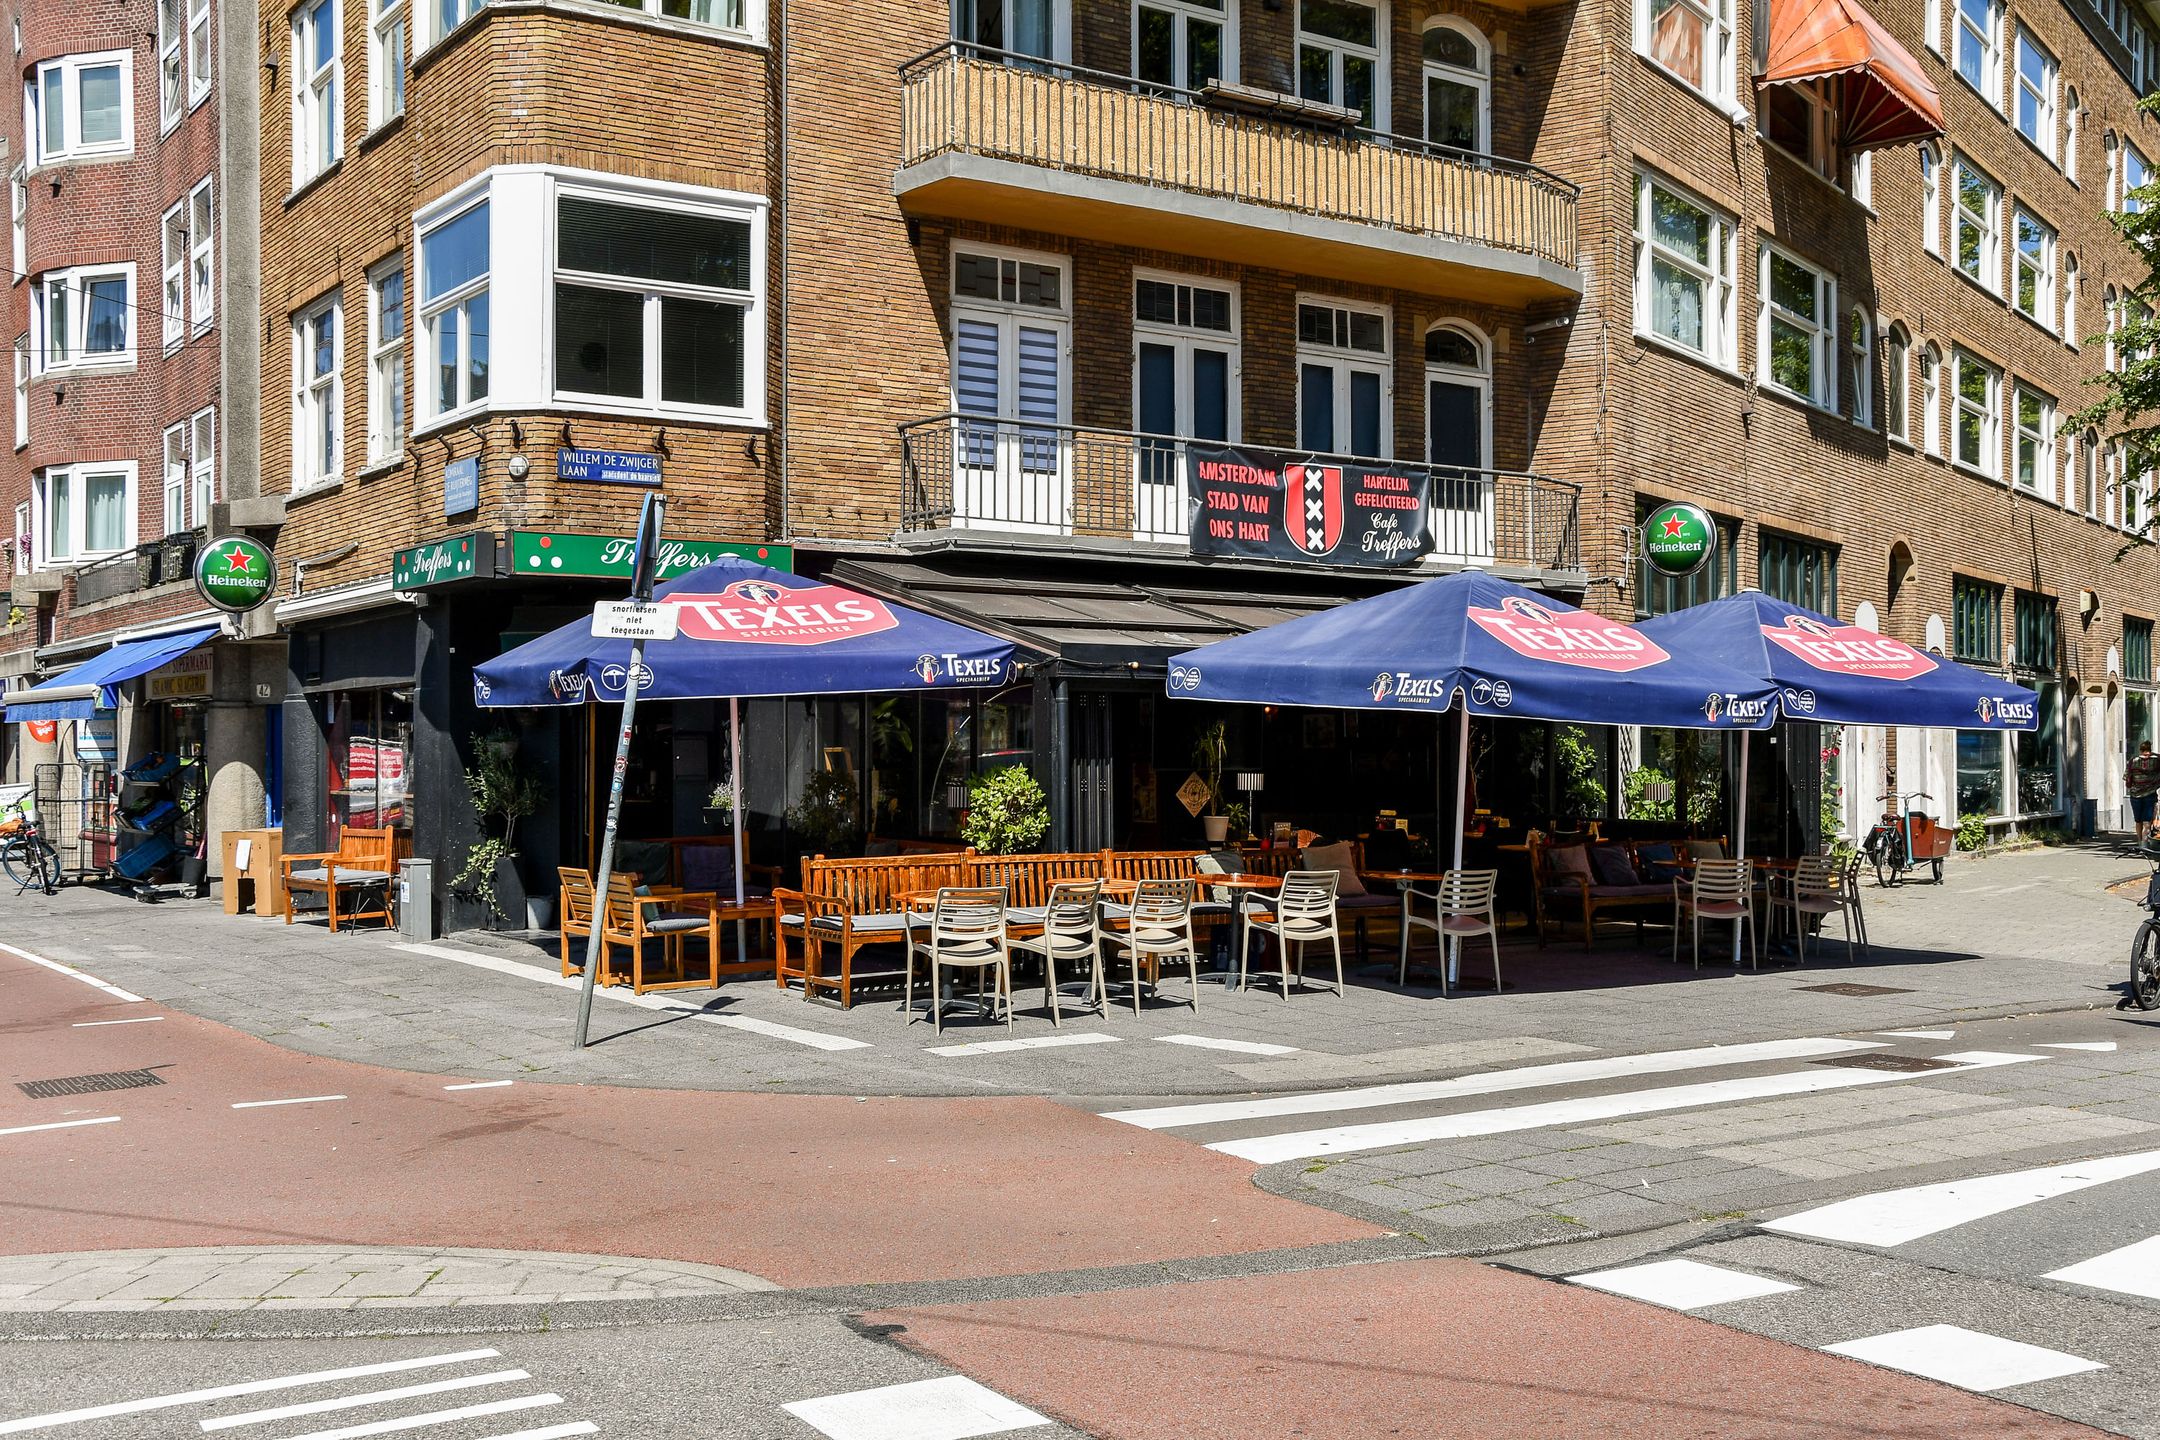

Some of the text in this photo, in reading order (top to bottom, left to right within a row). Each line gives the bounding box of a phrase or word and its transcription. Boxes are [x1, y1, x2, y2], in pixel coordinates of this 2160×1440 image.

[562, 465, 588, 477] LAAN
[563, 451, 659, 471] WILLEM DE ZWIJGER
[1199, 461, 1278, 487] AMSTERDAM
[1363, 475, 1410, 491] HARTELIJK
[1207, 490, 1270, 514] STAD VAN
[1355, 492, 1420, 510] GEFELICITEERD
[1209, 518, 1270, 542] ONS HART
[1371, 512, 1398, 535] Cafe
[1361, 531, 1421, 560] Treffers
[1649, 541, 1702, 553] Heineken
[413, 545, 452, 582] Treffers
[600, 539, 711, 577] Trffers
[207, 574, 267, 588] Heineken
[612, 605, 657, 614] snorfietsen
[626, 616, 642, 624] niet
[672, 599, 878, 631] TEXELS
[611, 626, 655, 636] toegestaan
[740, 625, 853, 638] SPECIAALBIER
[1479, 615, 1645, 651] TEXELS
[1771, 632, 1915, 662] TEXELS
[941, 654, 1001, 676] TEXELS
[1395, 673, 1444, 697] TEXELS
[1725, 693, 1767, 717] TEXELS
[1993, 698, 2033, 719] TEXELS
